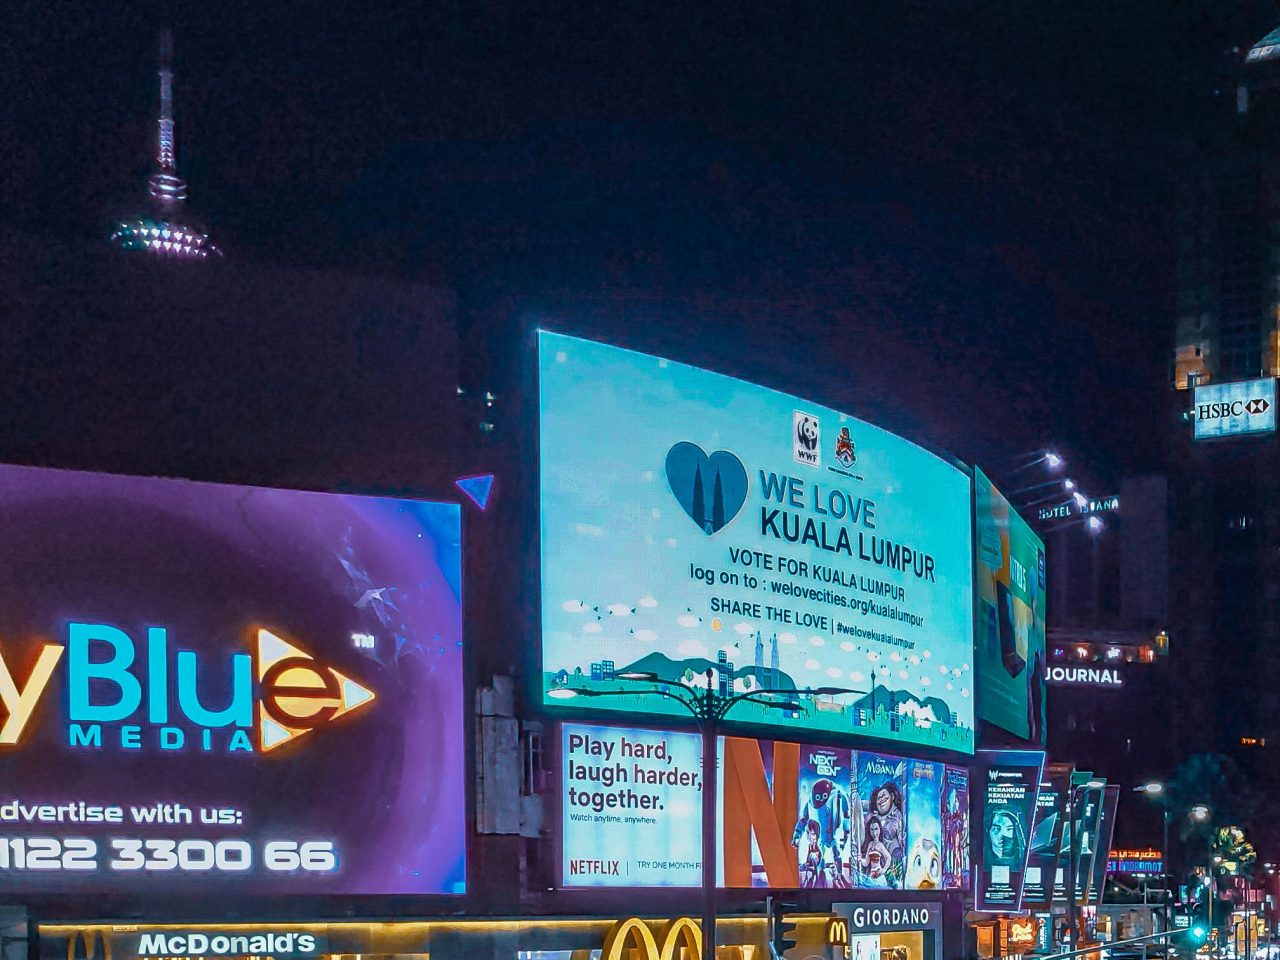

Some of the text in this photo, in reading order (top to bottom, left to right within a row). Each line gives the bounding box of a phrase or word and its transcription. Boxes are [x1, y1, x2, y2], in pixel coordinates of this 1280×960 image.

[1198, 401, 1244, 420] HSBC
[797, 449, 818, 463] WWF
[759, 469, 876, 529] WE LOVE
[760, 506, 936, 581] KUALA LUMPUR
[728, 546, 906, 602] VOTE FOR KUALA LUMPUR
[689, 562, 715, 585] log
[719, 570, 739, 586] on
[743, 573, 758, 590] to
[770, 580, 924, 628] welovecities.org/kualalumpur
[710, 597, 762, 619] SHARE
[764, 605, 792, 624] THE
[795, 608, 828, 631] LOVE
[351, 633, 375, 649] TM
[1045, 667, 1122, 684] JOURNAL
[69, 723, 253, 752] MEDIA
[569, 734, 672, 764] Play hard,
[809, 753, 838, 766] NEXT
[816, 766, 841, 776] GEN
[866, 760, 903, 779] MOANA
[569, 760, 703, 791] laugh harder,
[568, 787, 664, 813] together.
[0, 801, 243, 825] dvertise with us:
[570, 813, 658, 825] Watch anytime, anywhere.
[110, 839, 252, 871] 3300
[264, 841, 336, 872] 66
[637, 861, 651, 869] TRY
[652, 861, 667, 869] ONE
[669, 861, 695, 870] MONTH
[570, 859, 620, 876] NETFLIX
[853, 907, 930, 928] GIORDANO
[137, 932, 316, 955] McDonald's
